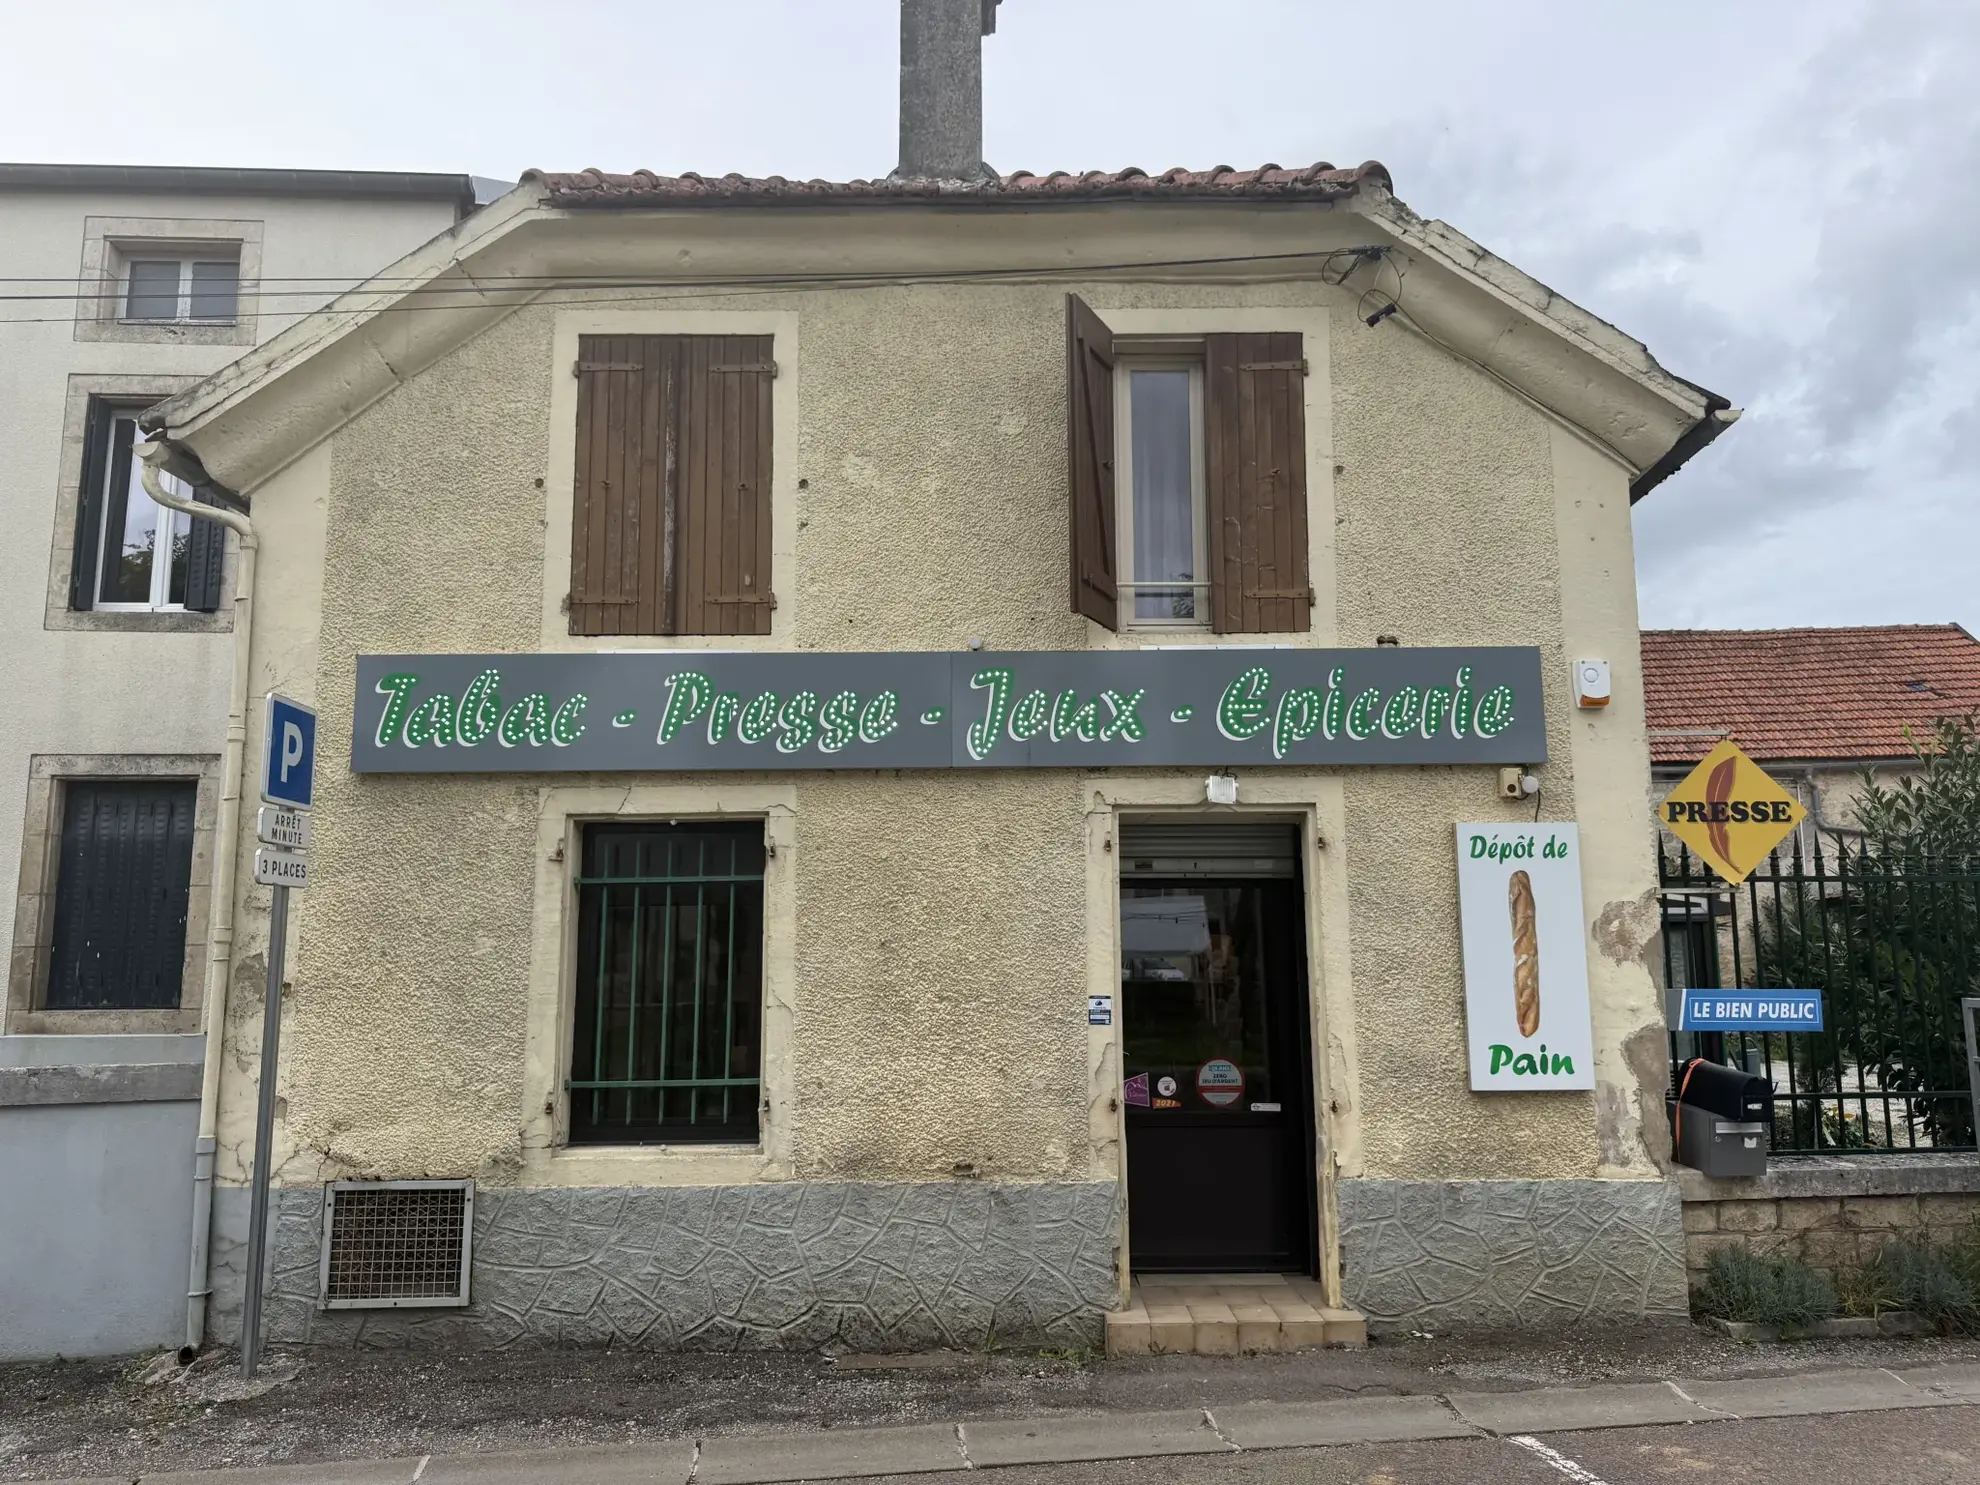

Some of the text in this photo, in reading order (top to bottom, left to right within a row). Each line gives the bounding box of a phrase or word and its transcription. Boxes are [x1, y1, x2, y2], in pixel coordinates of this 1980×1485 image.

[375, 669, 588, 748] Tabac
[656, 671, 899, 752] Presse
[966, 668, 1148, 760] Jeux
[1216, 664, 1516, 759] Epicerie
[280, 720, 303, 783] P
[275, 813, 301, 830] ARRÊT
[1666, 801, 1792, 823] PRESSE
[271, 827, 302, 844] MINUTE
[1469, 834, 1568, 864] Dépôt de
[263, 859, 306, 878] 3 PLACES
[1694, 1002, 1814, 1019] LE BIEN PUBLIC
[1488, 1044, 1575, 1076] Pain
